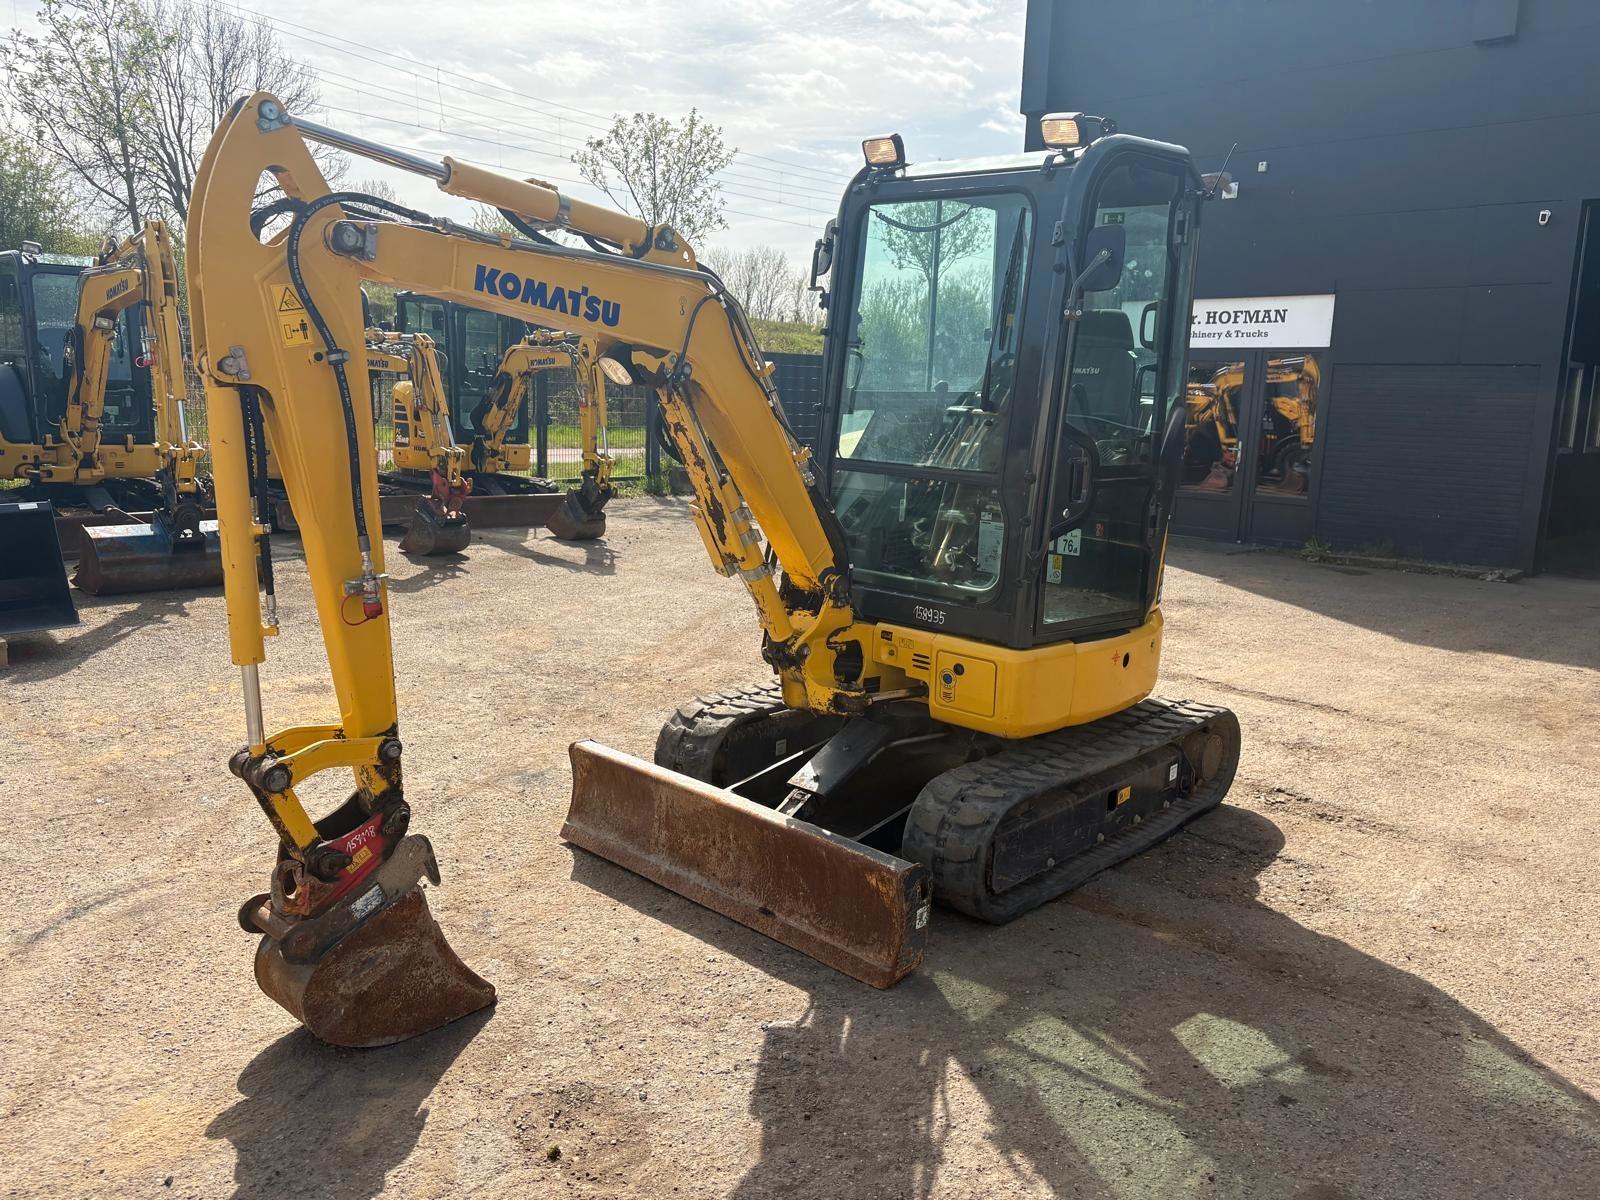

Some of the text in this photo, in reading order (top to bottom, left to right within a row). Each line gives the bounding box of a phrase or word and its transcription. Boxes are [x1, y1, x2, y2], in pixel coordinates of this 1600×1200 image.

[106, 278, 128, 300] KOMATSU
[474, 264, 621, 327] KOMATSU
[1205, 309, 1288, 325] HOFMAN
[1190, 329, 1269, 340] hinery & Trucks
[913, 605, 946, 625] 158935
